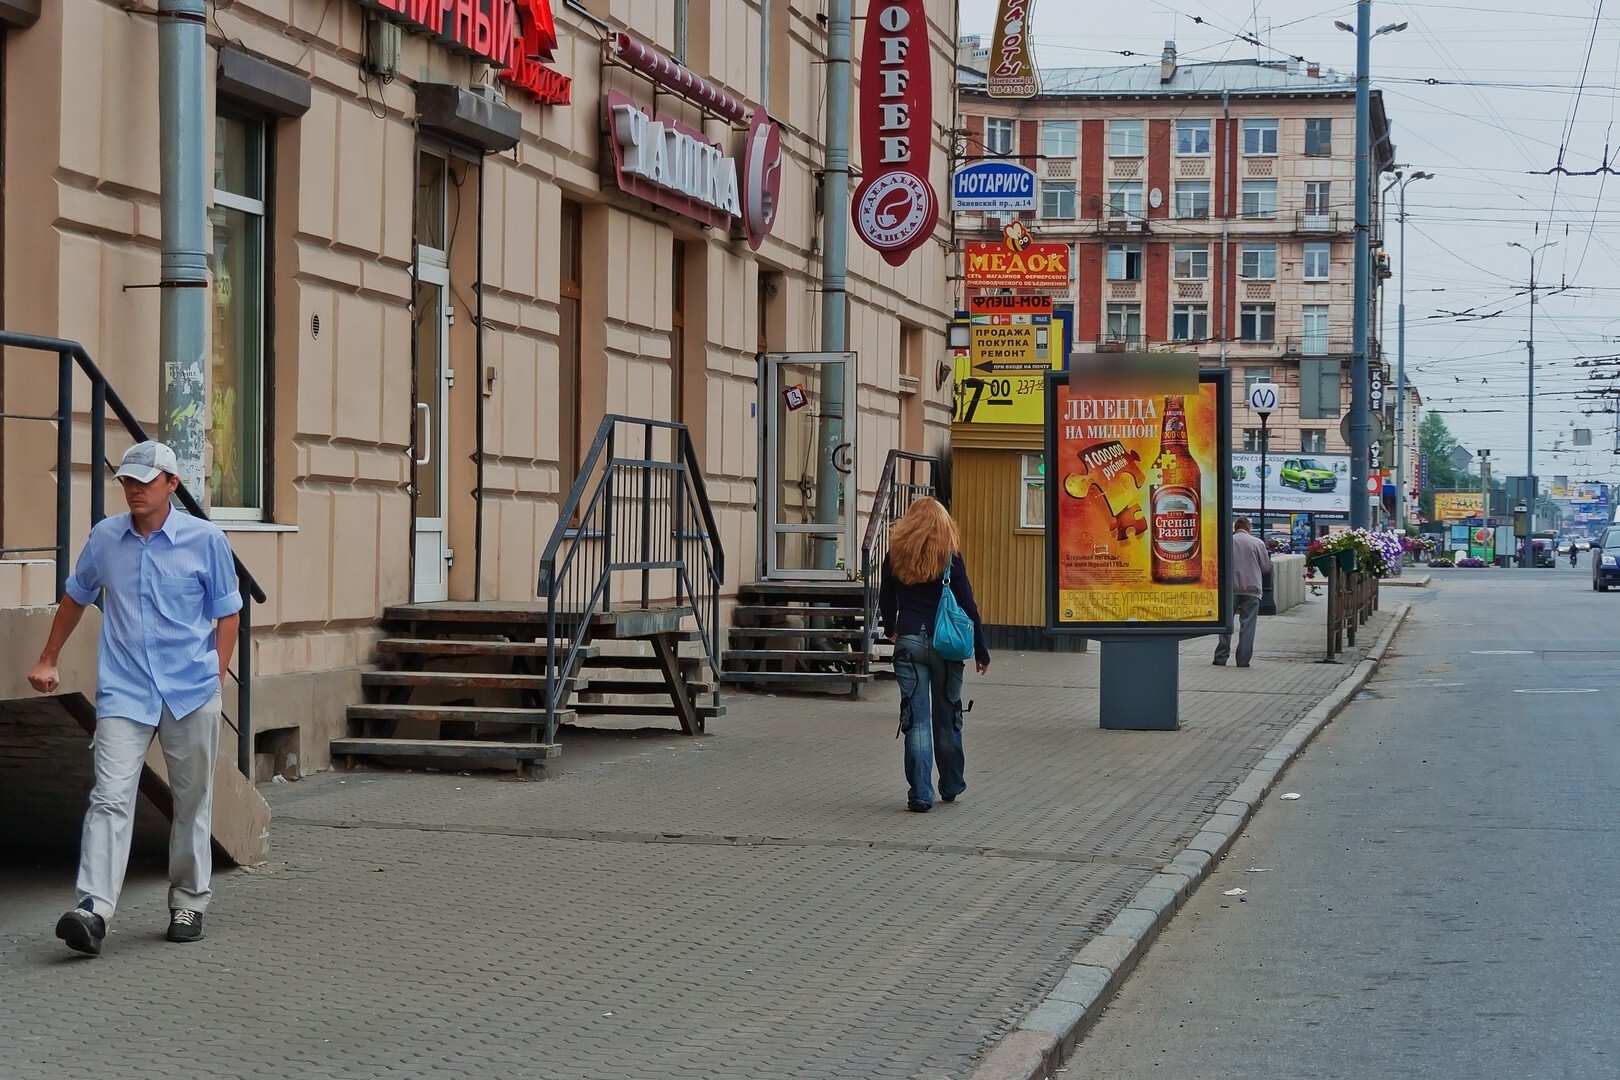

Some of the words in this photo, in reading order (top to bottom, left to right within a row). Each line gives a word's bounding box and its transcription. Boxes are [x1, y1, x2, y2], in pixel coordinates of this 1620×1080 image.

[878, 0, 911, 163] OFFEE
[613, 104, 742, 218] ЧАШКА
[958, 173, 1029, 193] НОТАРИУС
[864, 176, 923, 214] ИДЕАЛЬНАЯ
[869, 221, 918, 241] ЧАШКА
[968, 253, 1067, 274] МЕДОК
[972, 296, 1051, 309] ФЛЭШ-МОБ
[975, 329, 1031, 337] ПРОДАЖА
[980, 350, 1026, 358] РЕМОНТ
[1017, 379, 1035, 395] 237
[1064, 398, 1157, 424] ЛЕГЕНДА
[1065, 425, 1084, 439] НА
[1087, 424, 1159, 439] МИЛЛИОН!
[1101, 456, 1129, 481] рублей
[1155, 516, 1196, 528] Степан
[1158, 527, 1194, 539] Разин
[1063, 591, 1119, 606] ЧРЕЗМЕРНОЕ
[1121, 591, 1188, 606] УПОТРЕБЛЕНИЕ
[1190, 591, 1215, 606] ПИВА
[1075, 606, 1108, 620] ВРЕДИТ
